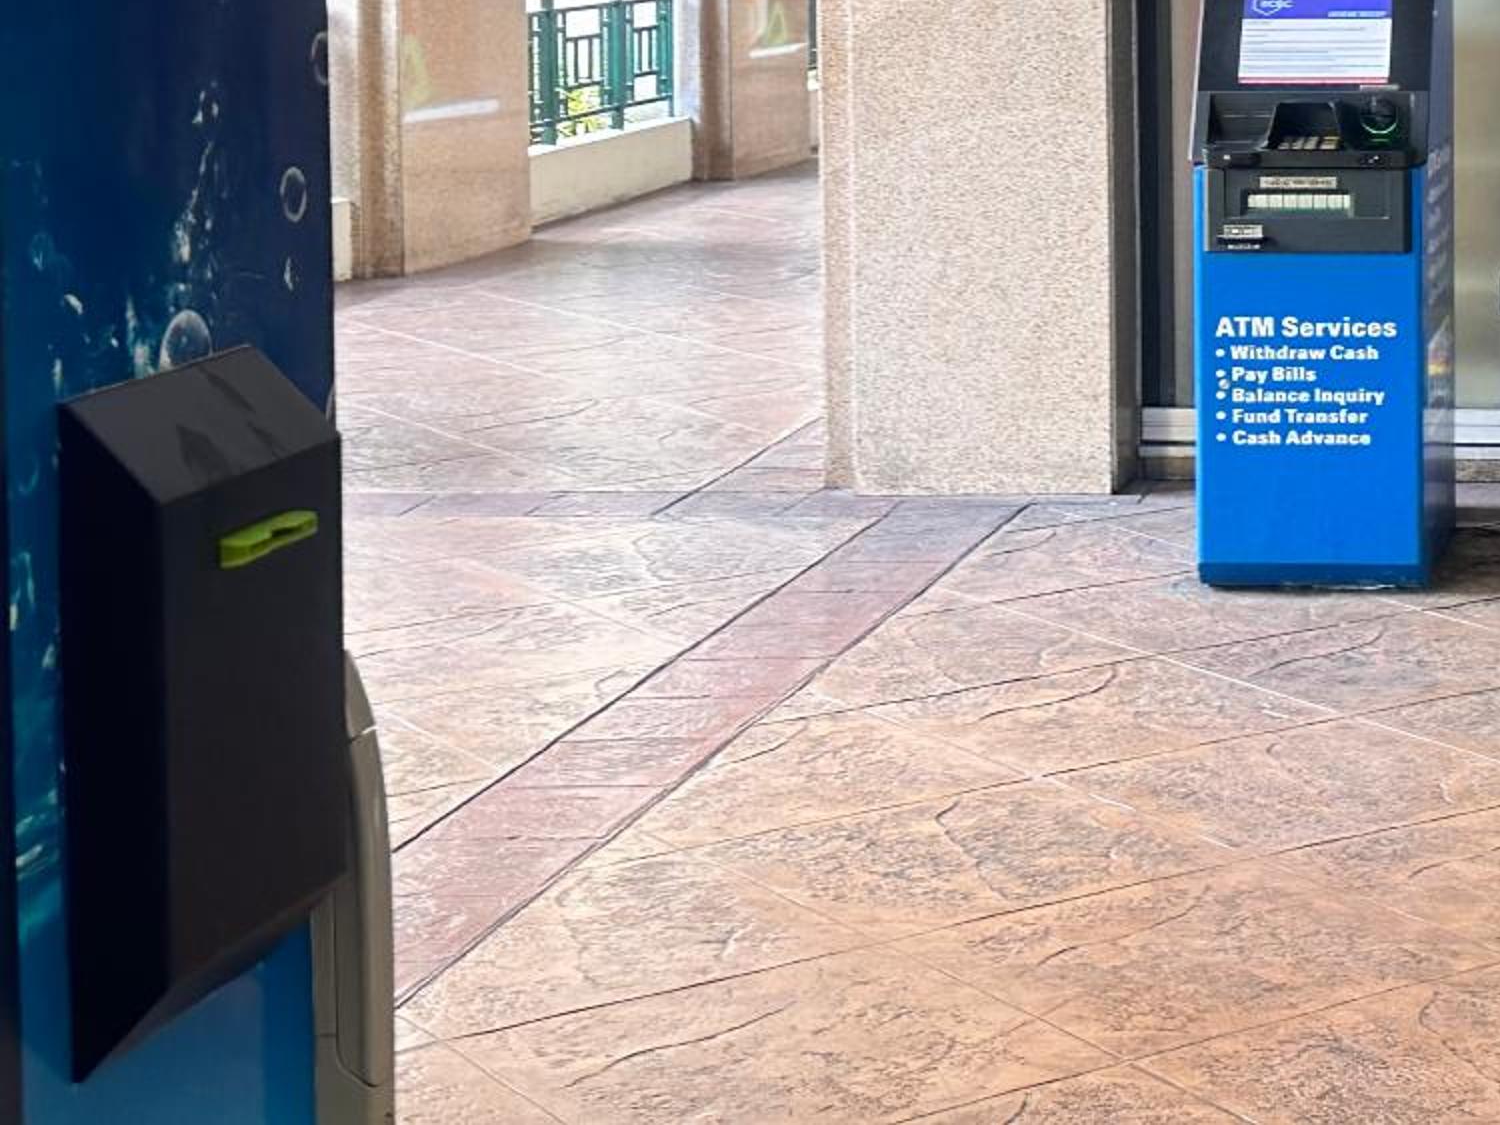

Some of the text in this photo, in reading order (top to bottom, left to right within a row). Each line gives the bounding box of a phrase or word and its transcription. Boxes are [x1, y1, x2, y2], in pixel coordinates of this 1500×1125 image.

[1215, 316, 1398, 338] ATM Services
[1230, 345, 1380, 360] Withdraw Cash
[1231, 367, 1317, 384] Pay Bills
[1232, 388, 1385, 405] Balance Inquiry
[1232, 409, 1369, 424] Fund Transfer
[1232, 430, 1371, 445] Cash Advance
